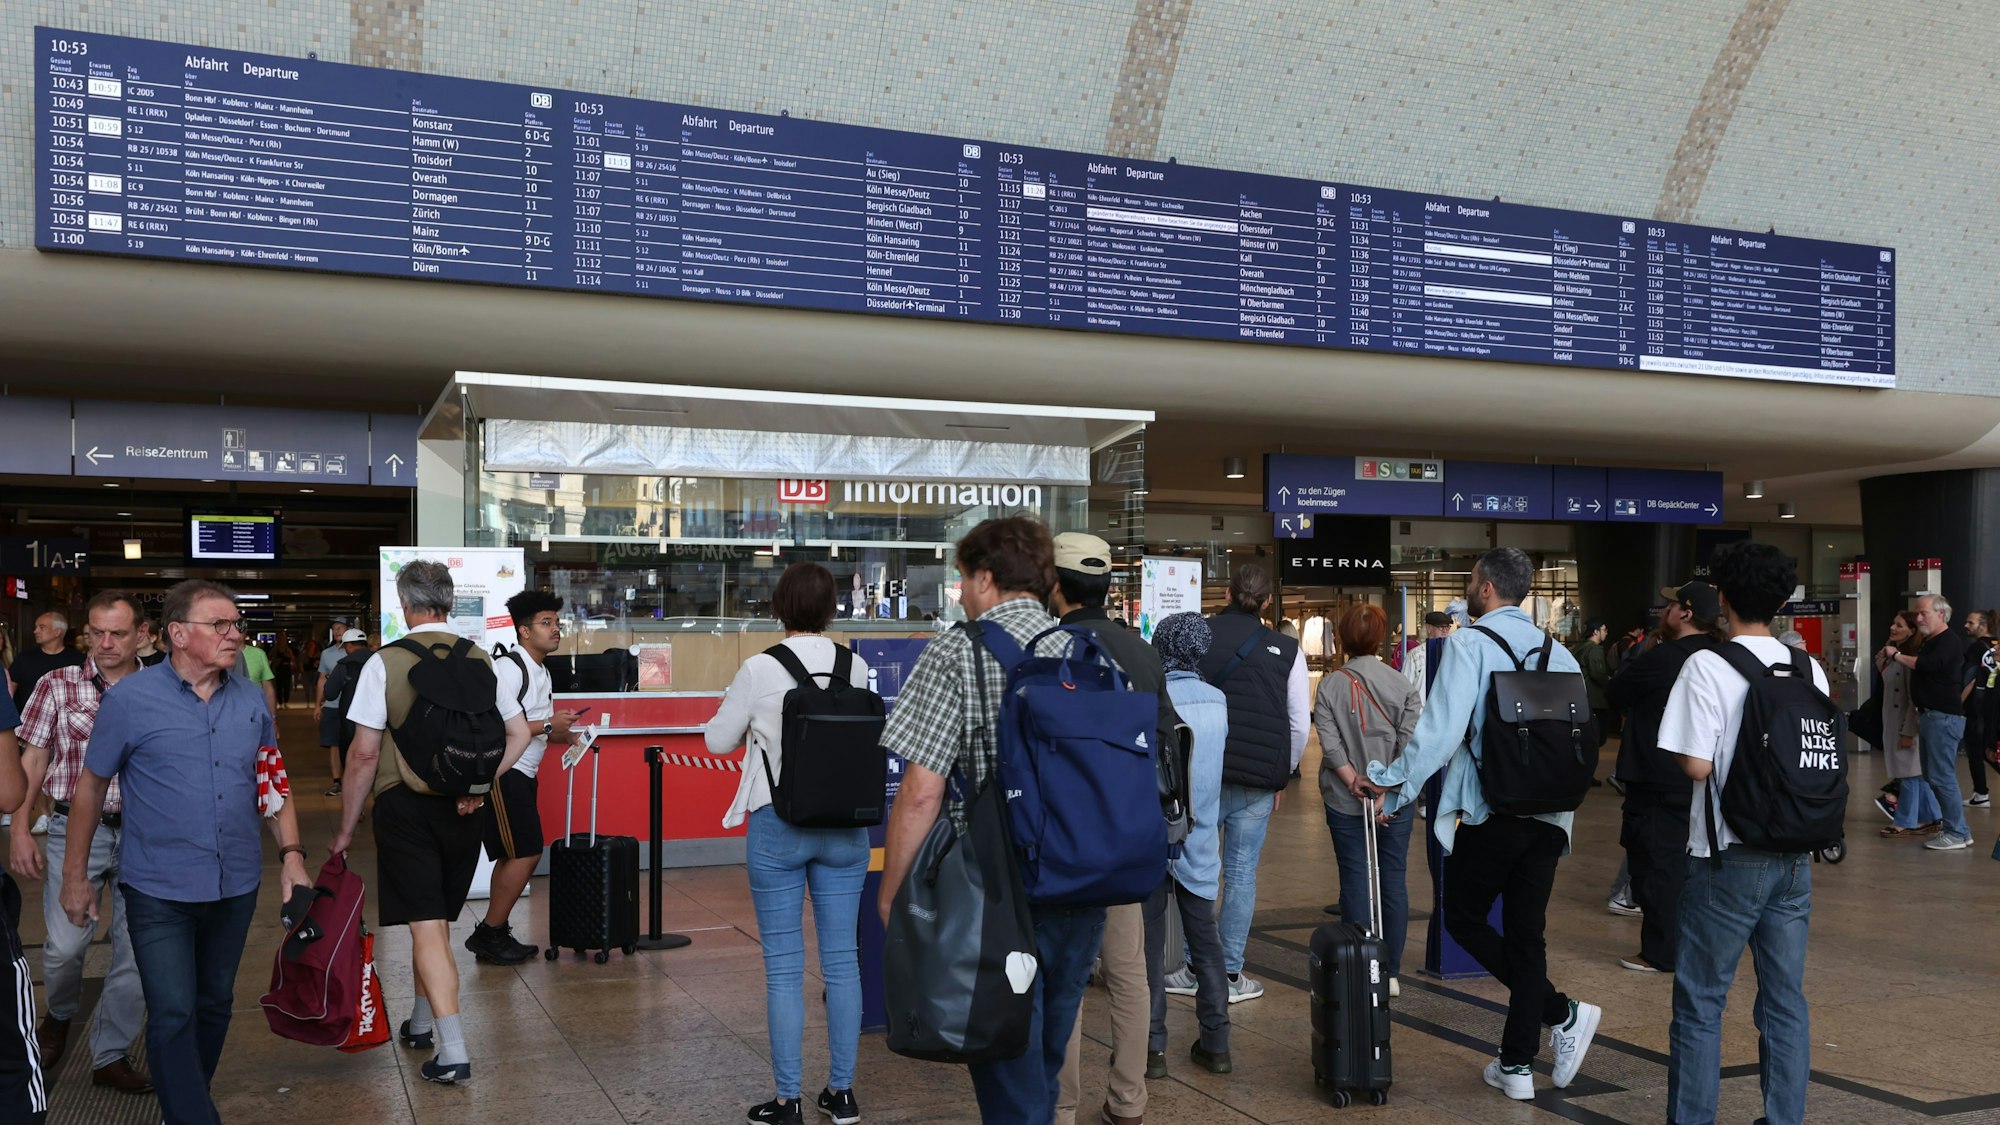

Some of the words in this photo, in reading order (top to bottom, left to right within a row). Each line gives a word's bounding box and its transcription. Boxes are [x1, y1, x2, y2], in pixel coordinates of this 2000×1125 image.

[52, 40, 87, 55] 10:53
[185, 56, 228, 72] Abfahrt
[244, 62, 298, 80] Departure
[53, 77, 83, 90] 10:43
[93, 82, 118, 94] 10:57
[128, 87, 135, 96] IC
[138, 88, 154, 97] 2005
[53, 96, 83, 110] 10:49
[532, 94, 550, 108] DB
[128, 106, 137, 114] RE
[146, 108, 167, 118] (RRX)
[575, 102, 603, 115] 10:53
[53, 116, 83, 129] 10:51
[93, 121, 118, 132] 10:59
[413, 118, 452, 131] Konstanz
[682, 115, 717, 129] Abfahrt
[730, 120, 774, 135] Departure
[525, 130, 531, 139] 6
[53, 135, 83, 148] 10:54
[413, 136, 440, 147] Hamm
[442, 138, 459, 151] (W)
[576, 136, 600, 147] 11:01
[526, 147, 531, 157] 2
[965, 146, 979, 158] DB
[53, 155, 83, 167] 10:54
[413, 153, 452, 166] Troisdorf
[576, 153, 600, 164] 11:05
[608, 158, 628, 167] 11:15
[1000, 152, 1023, 164] 10:53
[526, 165, 537, 175] 10
[866, 168, 876, 177] Au
[878, 170, 900, 181] (Sieg)
[1088, 163, 1116, 175] Abfahrt
[1127, 167, 1164, 180] Departure
[53, 174, 83, 186] 10:54
[412, 171, 447, 184] Overath
[576, 170, 600, 182] 11:07
[94, 178, 118, 189] 11:08
[526, 183, 537, 192] 10
[1000, 183, 1020, 193] 11:15
[413, 189, 457, 204] Dormagen
[576, 188, 600, 199] 11:07
[867, 184, 882, 194] Köln
[884, 186, 930, 199] Messe/Deutz
[1026, 186, 1044, 196] 11:26
[1322, 188, 1334, 198] DB
[53, 194, 84, 206] 10:56
[1000, 199, 1020, 209] 11:17
[1351, 193, 1371, 204] 10:53
[526, 200, 536, 210] 11
[576, 205, 600, 216] 11:07
[867, 200, 897, 212] Bergisch
[899, 204, 931, 216] Gladbach
[1425, 202, 1450, 213] Abfahrt
[1458, 205, 1489, 218] Departure
[413, 207, 440, 219] Zürich
[1240, 209, 1262, 218] Aachen
[53, 213, 83, 225] 10:58
[94, 216, 118, 228] 11:47
[526, 218, 531, 227] 7
[867, 217, 893, 227] Minden
[896, 220, 922, 232] (Westf)
[576, 222, 600, 233] 11:10
[1240, 224, 1273, 235] Oberstdorf
[1352, 221, 1368, 230] 11:31
[1624, 222, 1634, 232] DB
[413, 226, 439, 237] Mainz
[1648, 228, 1665, 238] 10:53
[54, 232, 84, 244] 11:00
[526, 235, 531, 245] 9
[867, 233, 882, 242] Köln
[884, 235, 920, 248] Hansaring
[1352, 236, 1368, 244] 11:34
[1711, 235, 1732, 245] Abfahrt
[1739, 238, 1766, 249] Departure
[576, 240, 600, 251] 11:11
[1240, 239, 1265, 248] Münster
[1267, 242, 1278, 251] (W)
[526, 253, 531, 262] 2
[867, 250, 919, 262] Köln-Ehrenfeld
[1240, 254, 1252, 262] Kall
[1352, 250, 1369, 259] 11:36
[1648, 253, 1663, 262] 11:43
[1881, 252, 1889, 261] DB
[413, 262, 439, 272] Düren
[576, 257, 600, 268] 11:12
[527, 271, 537, 280] 11
[867, 266, 892, 276] Hennef
[1240, 268, 1264, 278] Overath
[1554, 270, 1590, 280] Bonn-Mehlem
[576, 275, 600, 285] 11:14
[1240, 283, 1294, 296] Mönchengladbach
[1566, 286, 1592, 296] Hansaring
[1240, 298, 1246, 307] W
[1247, 299, 1284, 309] Oberbarmen
[1554, 298, 1574, 306] Koblenz
[1240, 313, 1266, 323] Bergisch
[1267, 315, 1294, 325] Gladbach
[1240, 328, 1285, 339] Köln-Ehrenfeld
[1554, 324, 1572, 333] Sindorf
[1554, 338, 1572, 347] Hennef
[1554, 352, 1572, 360] Krefeld
[126, 446, 208, 459] ReiseZentrum
[1380, 463, 1390, 477] S
[781, 479, 826, 500] DB
[844, 480, 1041, 507] Information
[1308, 487, 1322, 495] den
[1324, 487, 1346, 497] Zügen
[1298, 498, 1338, 507] koelnmesse
[1657, 500, 1700, 510] GepäckCenter
[1297, 513, 1304, 530] 1
[26, 541, 38, 567] 1
[51, 553, 86, 568] A-F
[449, 559, 462, 567] DB
[1292, 558, 1384, 568] ETERNA
[1801, 718, 1832, 736] NIKE
[1802, 735, 1836, 750] NIKE
[1799, 751, 1839, 770] NIKE
